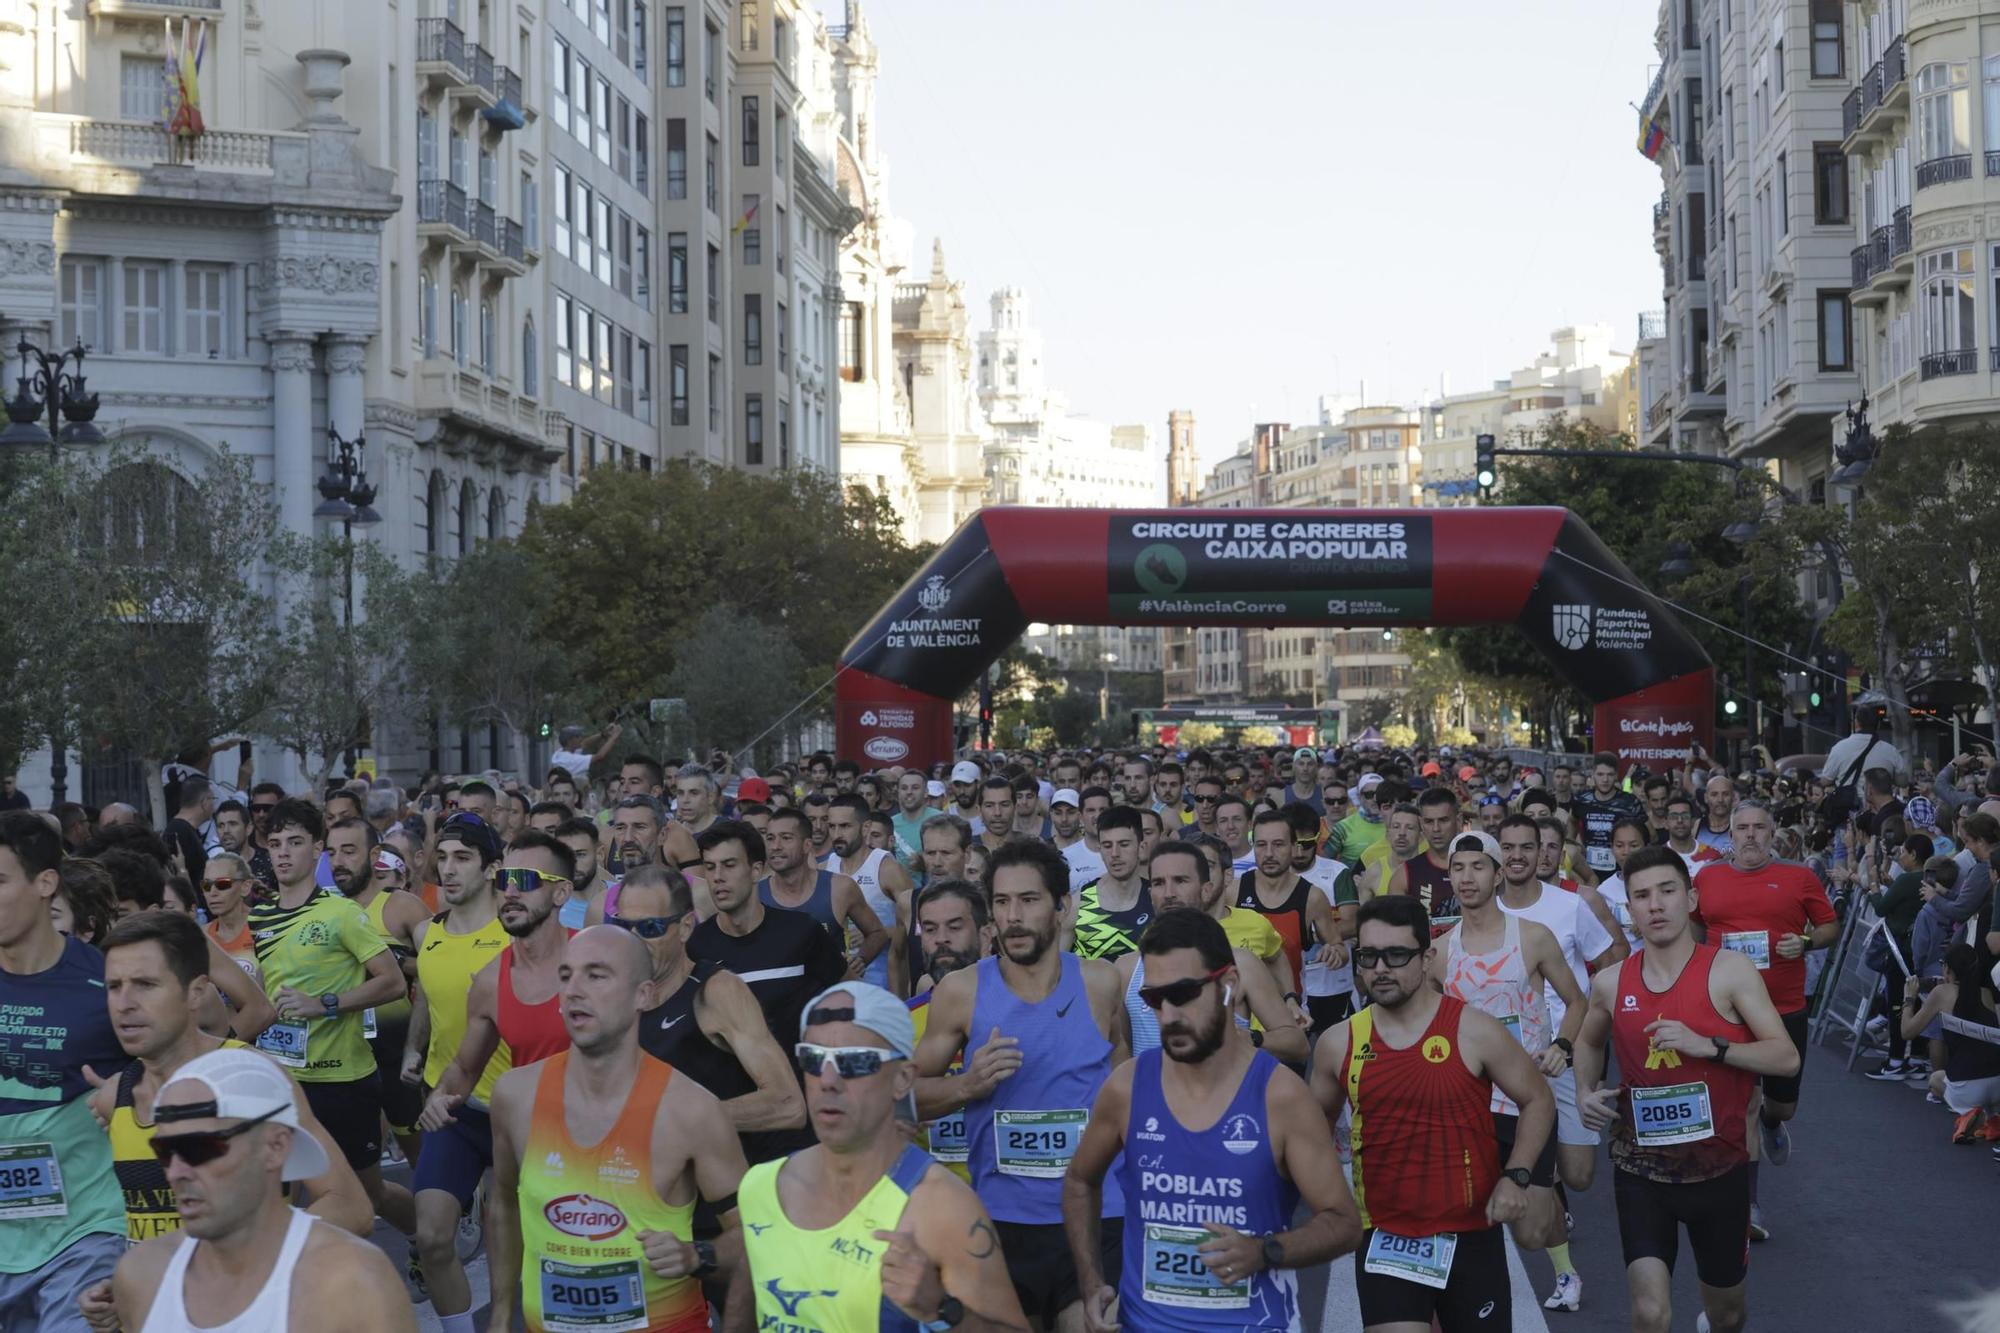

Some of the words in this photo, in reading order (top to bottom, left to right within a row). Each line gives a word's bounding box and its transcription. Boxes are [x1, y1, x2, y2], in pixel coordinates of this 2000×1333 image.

[1132, 522, 1227, 538] CIRCUIT
[1233, 523, 1266, 538] DE
[1270, 523, 1406, 539] CARRERES
[1138, 599, 1287, 614] #ValènciaCorre
[1596, 608, 1647, 619] Fundació
[888, 619, 982, 632] AJUNTAMENT
[1596, 619, 1650, 629] Esportiva
[887, 635, 905, 647] DE
[910, 632, 981, 647] VALÈNCIA
[1595, 630, 1652, 639] Municipal
[2, 1004, 45, 1016] PUJADA
[9, 1015, 25, 1025] LA
[261, 1029, 293, 1045] 2423
[1641, 1102, 1692, 1122] 2085
[1009, 1131, 1067, 1149] 2219
[1136, 1132, 1166, 1142] VIATOR
[1142, 1171, 1243, 1198] POBLATS
[553, 1205, 620, 1227] Serrano
[1140, 1198, 1248, 1225] MARÍTIMS
[546, 1241, 567, 1255] COME
[570, 1245, 592, 1257] BIEN
[601, 1247, 632, 1257] CORRE
[1379, 1234, 1435, 1258] 2083
[1155, 1251, 1212, 1276] 220
[552, 1283, 620, 1306] 2005
